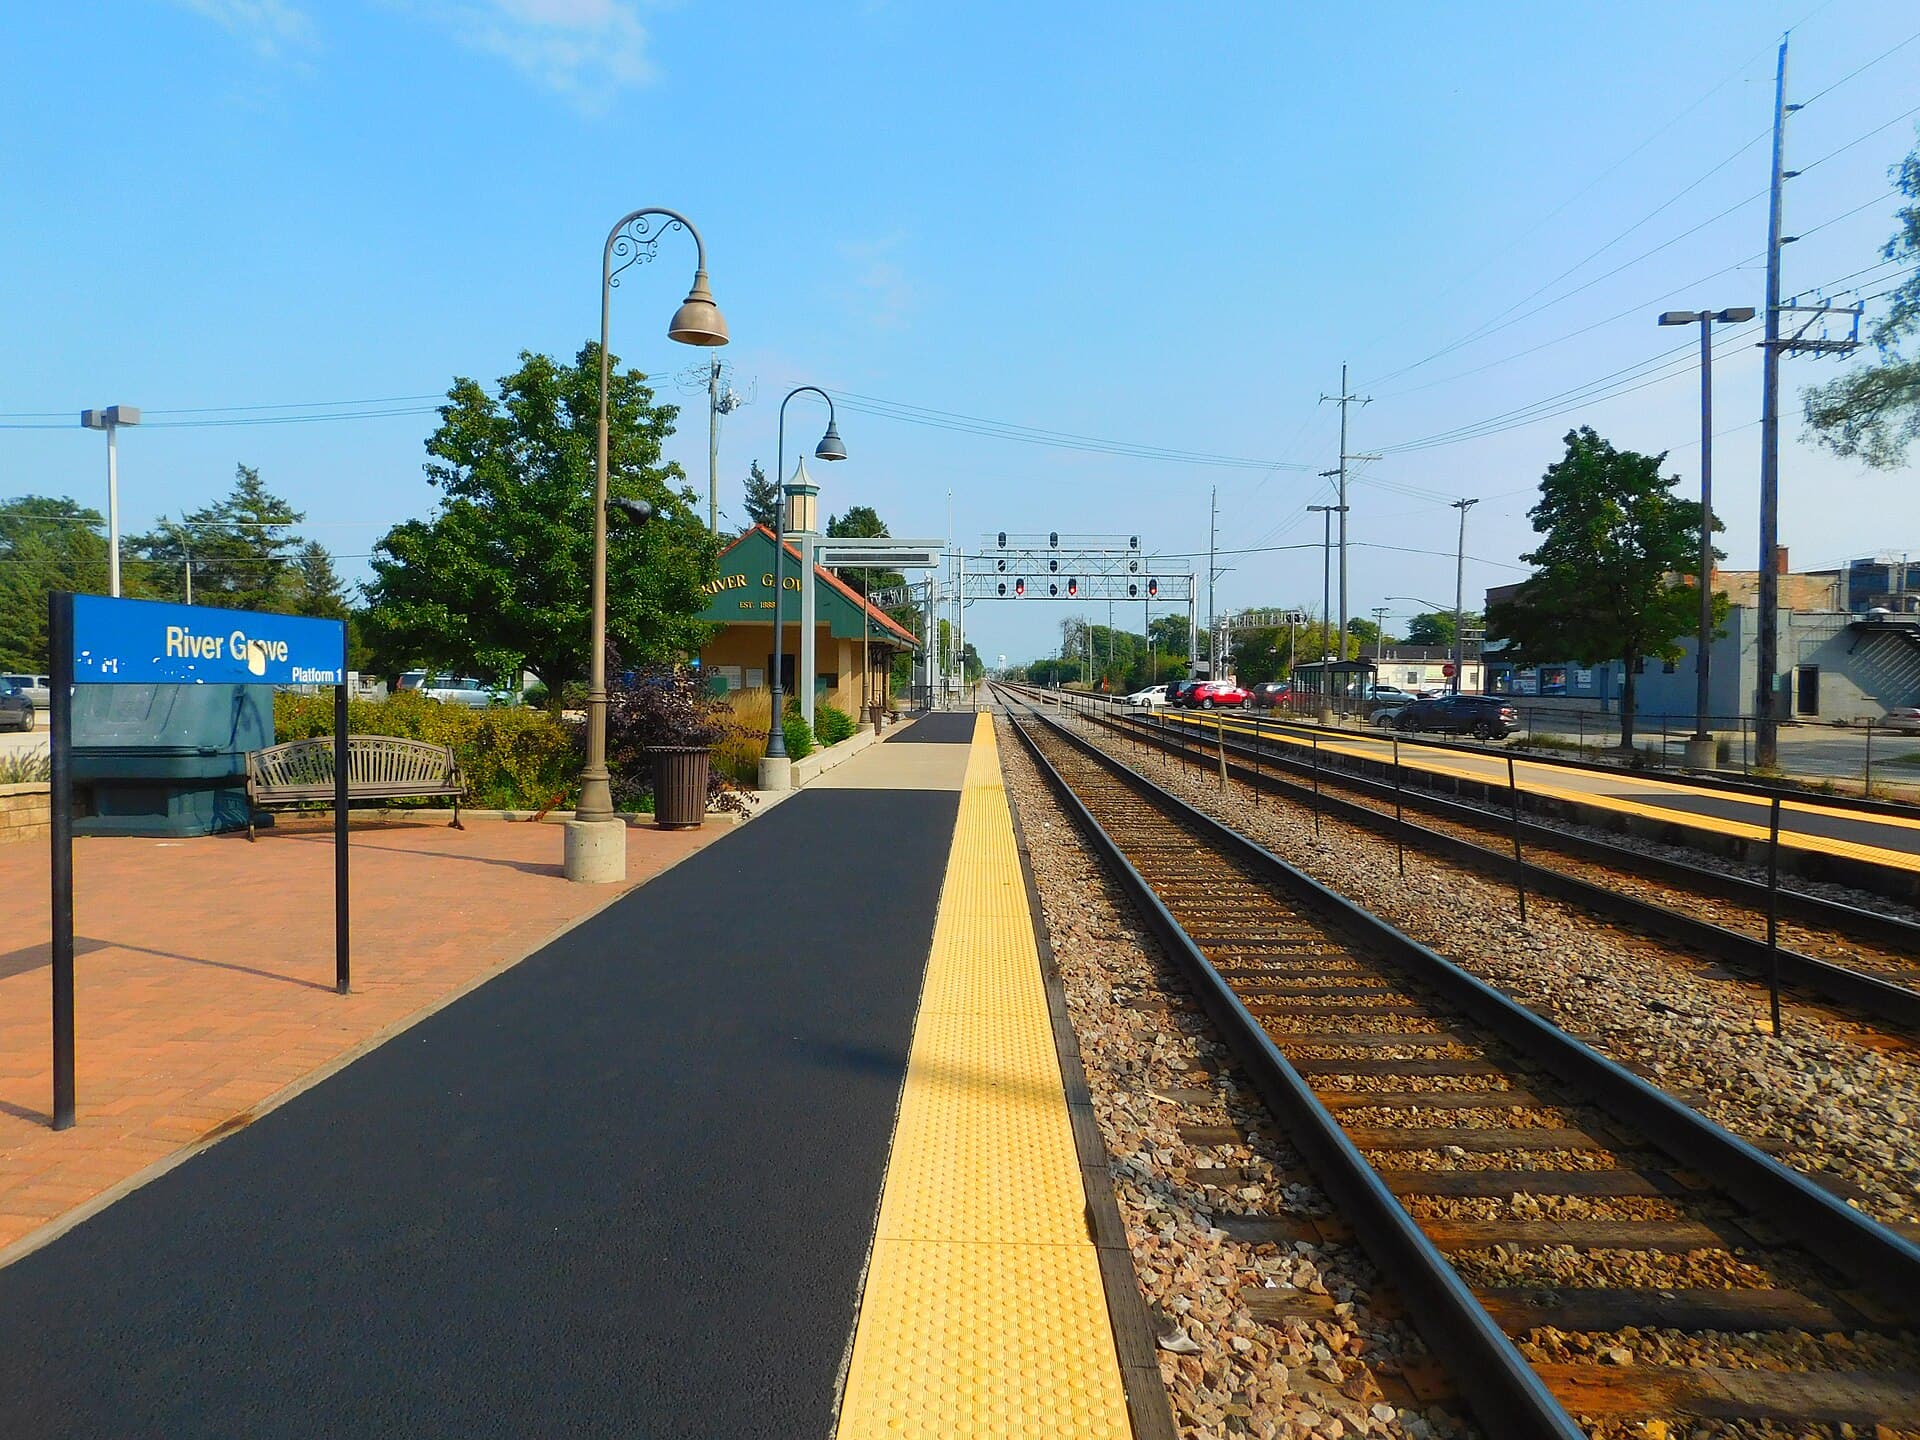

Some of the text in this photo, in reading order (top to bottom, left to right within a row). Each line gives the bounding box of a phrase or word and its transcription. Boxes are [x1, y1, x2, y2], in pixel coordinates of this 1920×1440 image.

[166, 626, 224, 659] River
[292, 666, 342, 682] Platform 1
